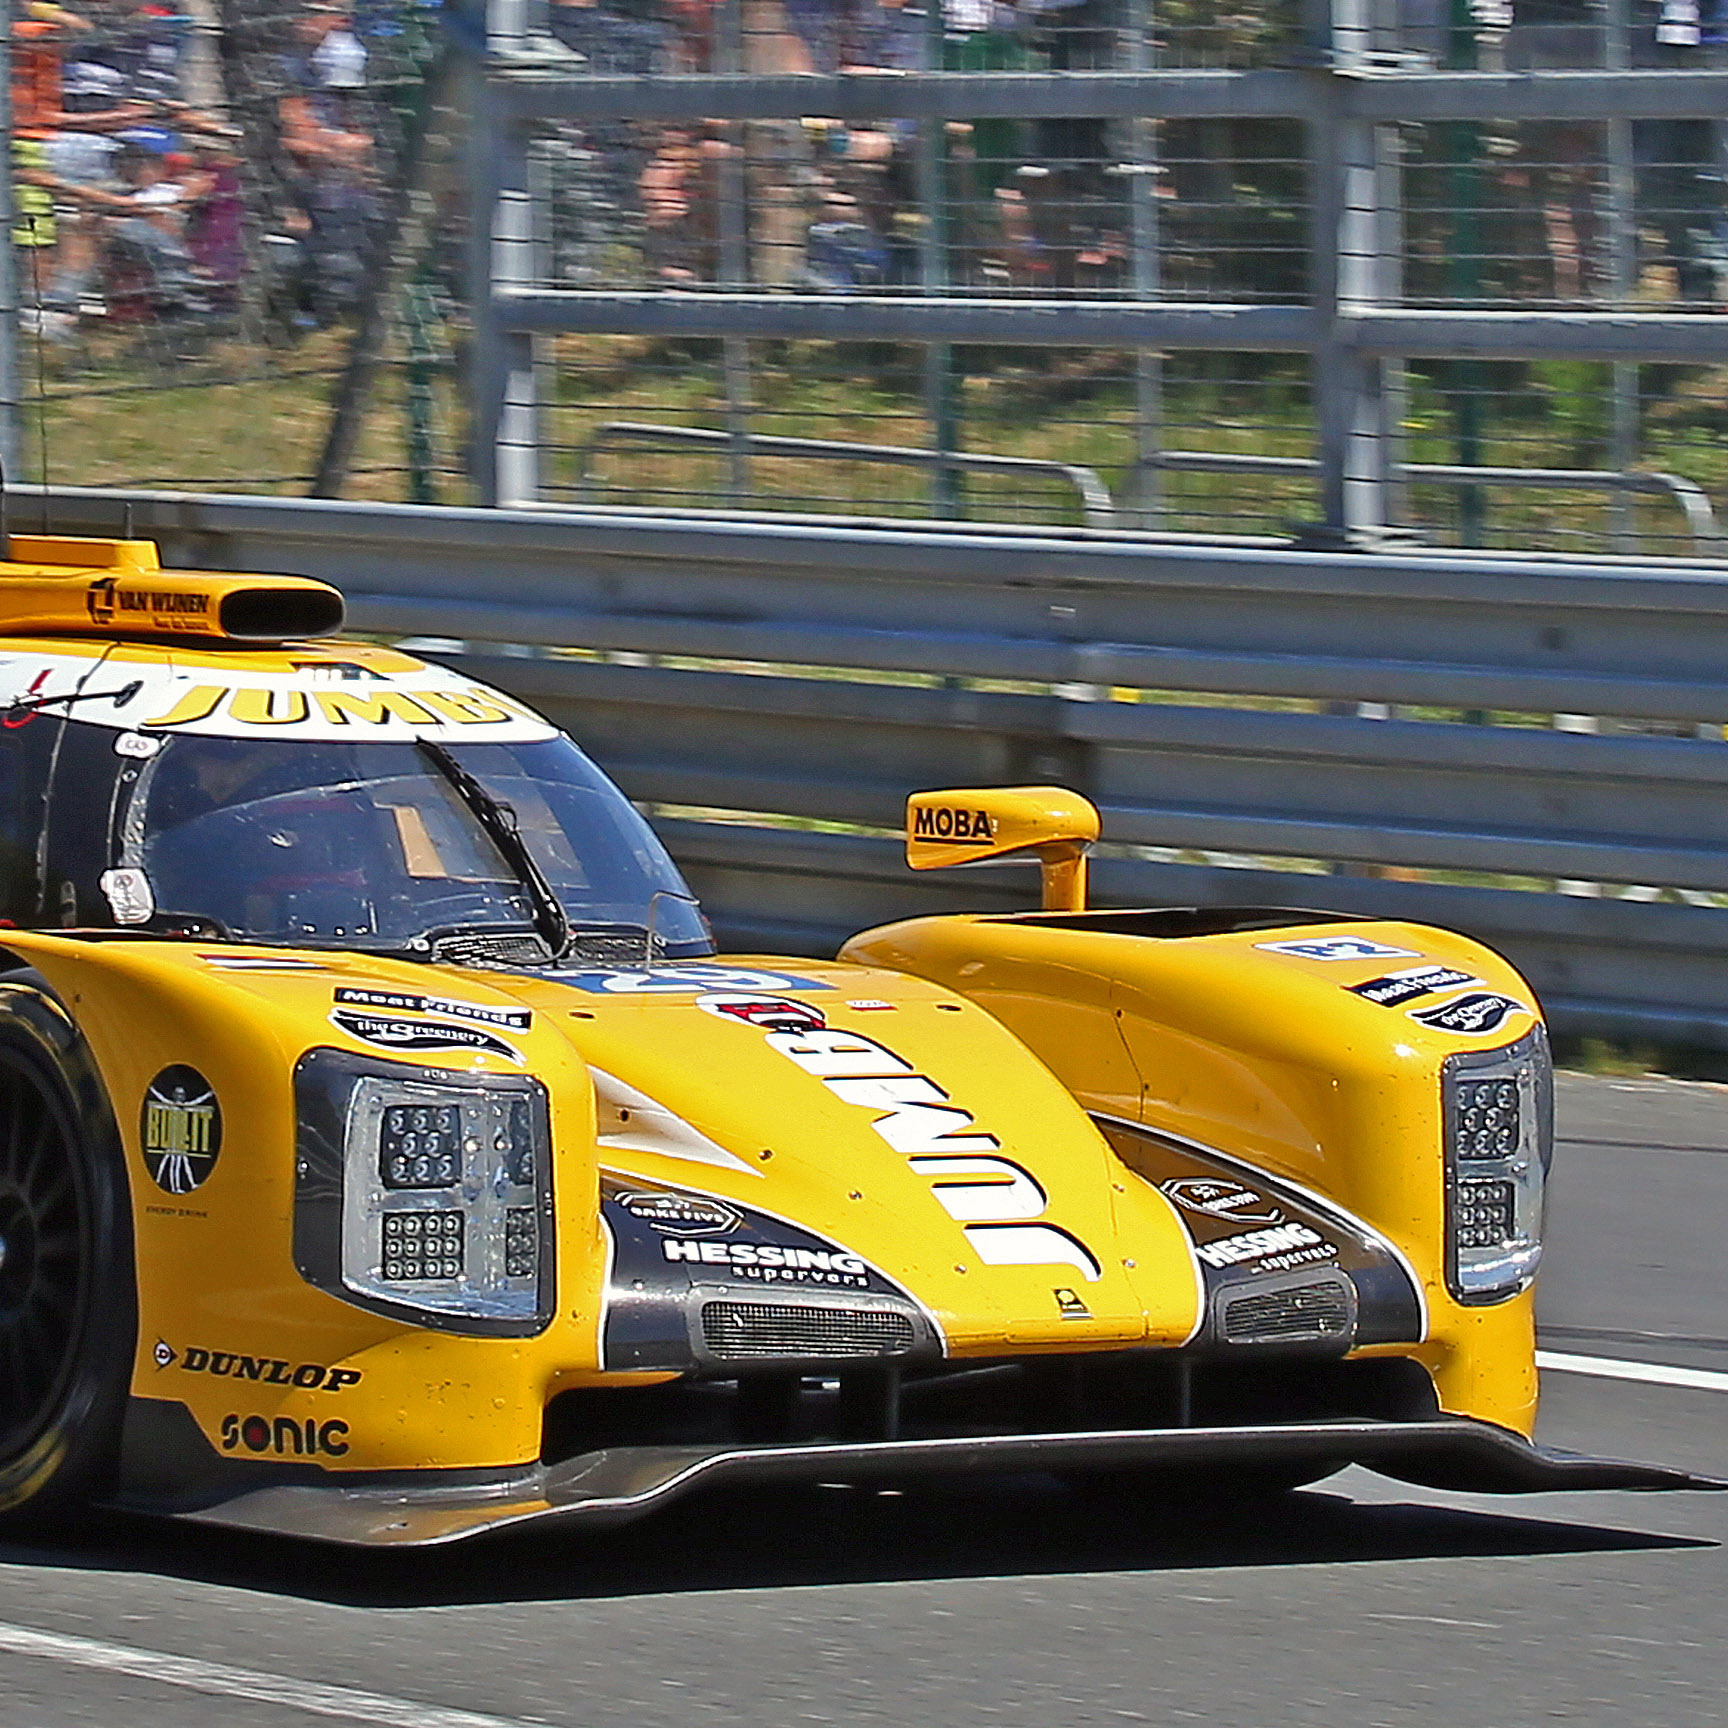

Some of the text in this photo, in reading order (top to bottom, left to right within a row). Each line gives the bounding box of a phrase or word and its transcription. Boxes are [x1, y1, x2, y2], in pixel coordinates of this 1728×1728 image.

[914, 806, 993, 838] MOBA
[664, 1239, 867, 1275] HESSING
[1196, 1223, 1324, 1268] HESSING
[181, 1346, 362, 1392] DUNLOP
